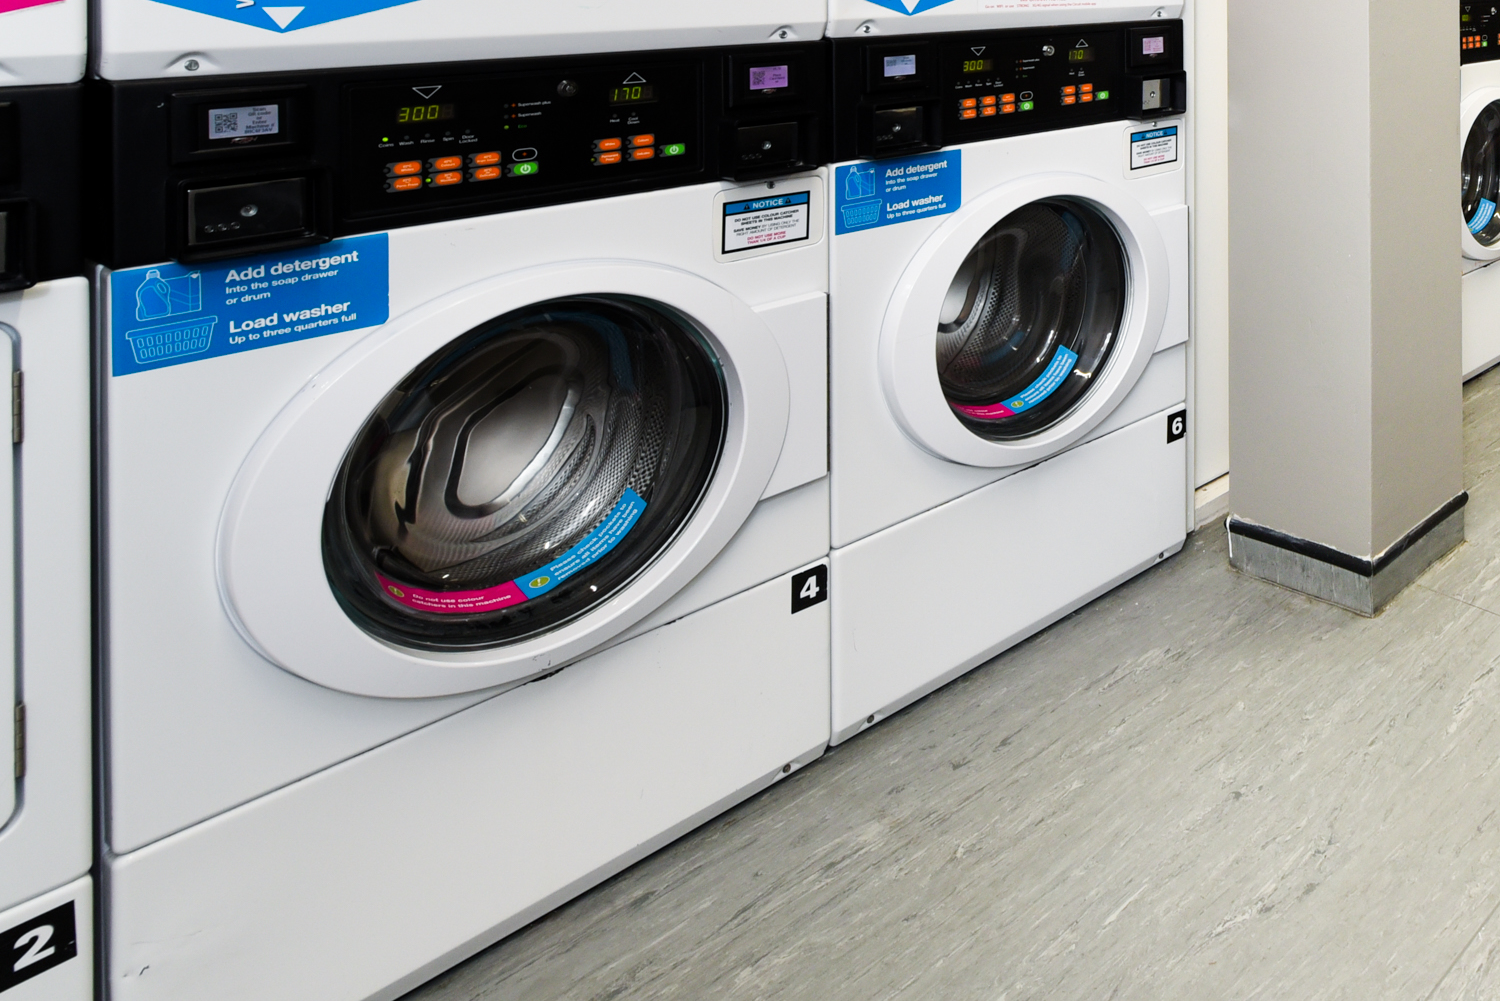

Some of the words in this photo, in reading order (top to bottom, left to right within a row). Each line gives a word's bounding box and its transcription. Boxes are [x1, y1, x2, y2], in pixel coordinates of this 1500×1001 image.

[964, 60, 983, 72] 300
[614, 86, 641, 101] 170
[399, 105, 439, 123] 300
[1146, 130, 1163, 138] NOTICE
[886, 167, 904, 178] Add
[906, 160, 948, 174] detergent
[752, 198, 783, 209] NOTICE
[887, 199, 910, 212] Load
[911, 194, 944, 207] washer
[225, 265, 265, 283] Add
[270, 250, 359, 276] detergent
[226, 285, 248, 294] Into
[250, 280, 269, 290] the
[272, 276, 299, 287] soap
[301, 270, 339, 282] drawer
[241, 292, 271, 303] drum
[230, 313, 278, 333] Load
[283, 302, 351, 323] washer
[230, 336, 246, 345] Up
[249, 333, 260, 341] to
[263, 327, 292, 338] three
[294, 318, 339, 332] quarters
[341, 313, 357, 323] full
[1172, 417, 1183, 435] 6
[550, 554, 576, 571] Please
[577, 538, 599, 555] check
[598, 512, 622, 537] pockets
[554, 559, 580, 576] ensure
[582, 552, 591, 560] all
[590, 535, 610, 552] items
[608, 518, 624, 535] have
[622, 502, 635, 518] been
[558, 558, 591, 581] removed
[592, 544, 608, 559] prior
[608, 536, 616, 544] to
[615, 508, 638, 536] washing
[799, 575, 820, 599] 4
[476, 595, 512, 606] machine
[13, 924, 56, 973] 2
